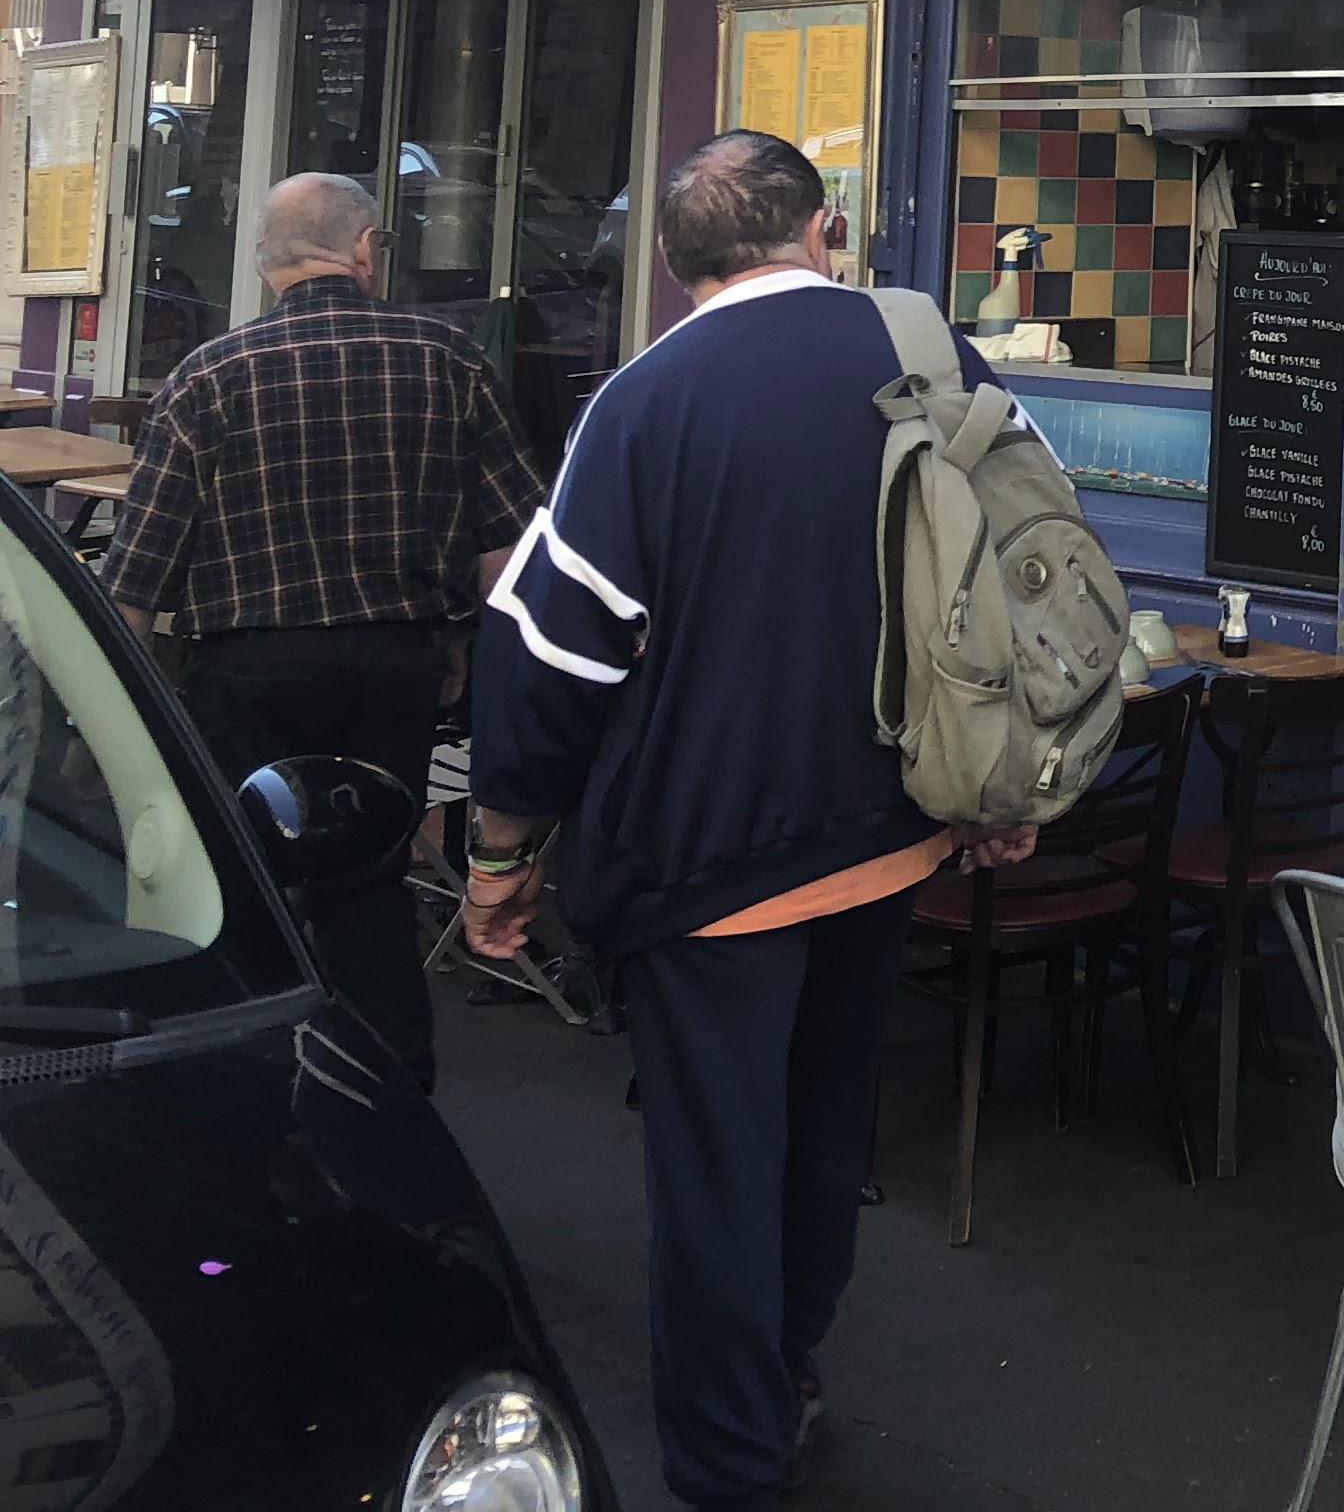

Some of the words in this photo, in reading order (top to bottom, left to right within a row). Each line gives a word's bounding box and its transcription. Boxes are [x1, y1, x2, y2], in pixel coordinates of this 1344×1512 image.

[1268, 289, 1283, 301] DU
[1285, 290, 1313, 305] JOUR
[1249, 330, 1288, 343] POIRES
[1280, 353, 1322, 369] PISTACHE
[1248, 366, 1294, 384] AMANDES
[1228, 414, 1258, 428] GLACE
[1262, 417, 1277, 430] DU
[1249, 444, 1277, 459] GLACE
[1281, 450, 1319, 467] VANILLE
[1247, 464, 1276, 481] GLACE
[1279, 470, 1324, 487] PISTACHE
[1245, 485, 1289, 503] CHOCOLAT
[1292, 492, 1325, 509] FONDU
[1243, 504, 1298, 524] CHANTILLY
